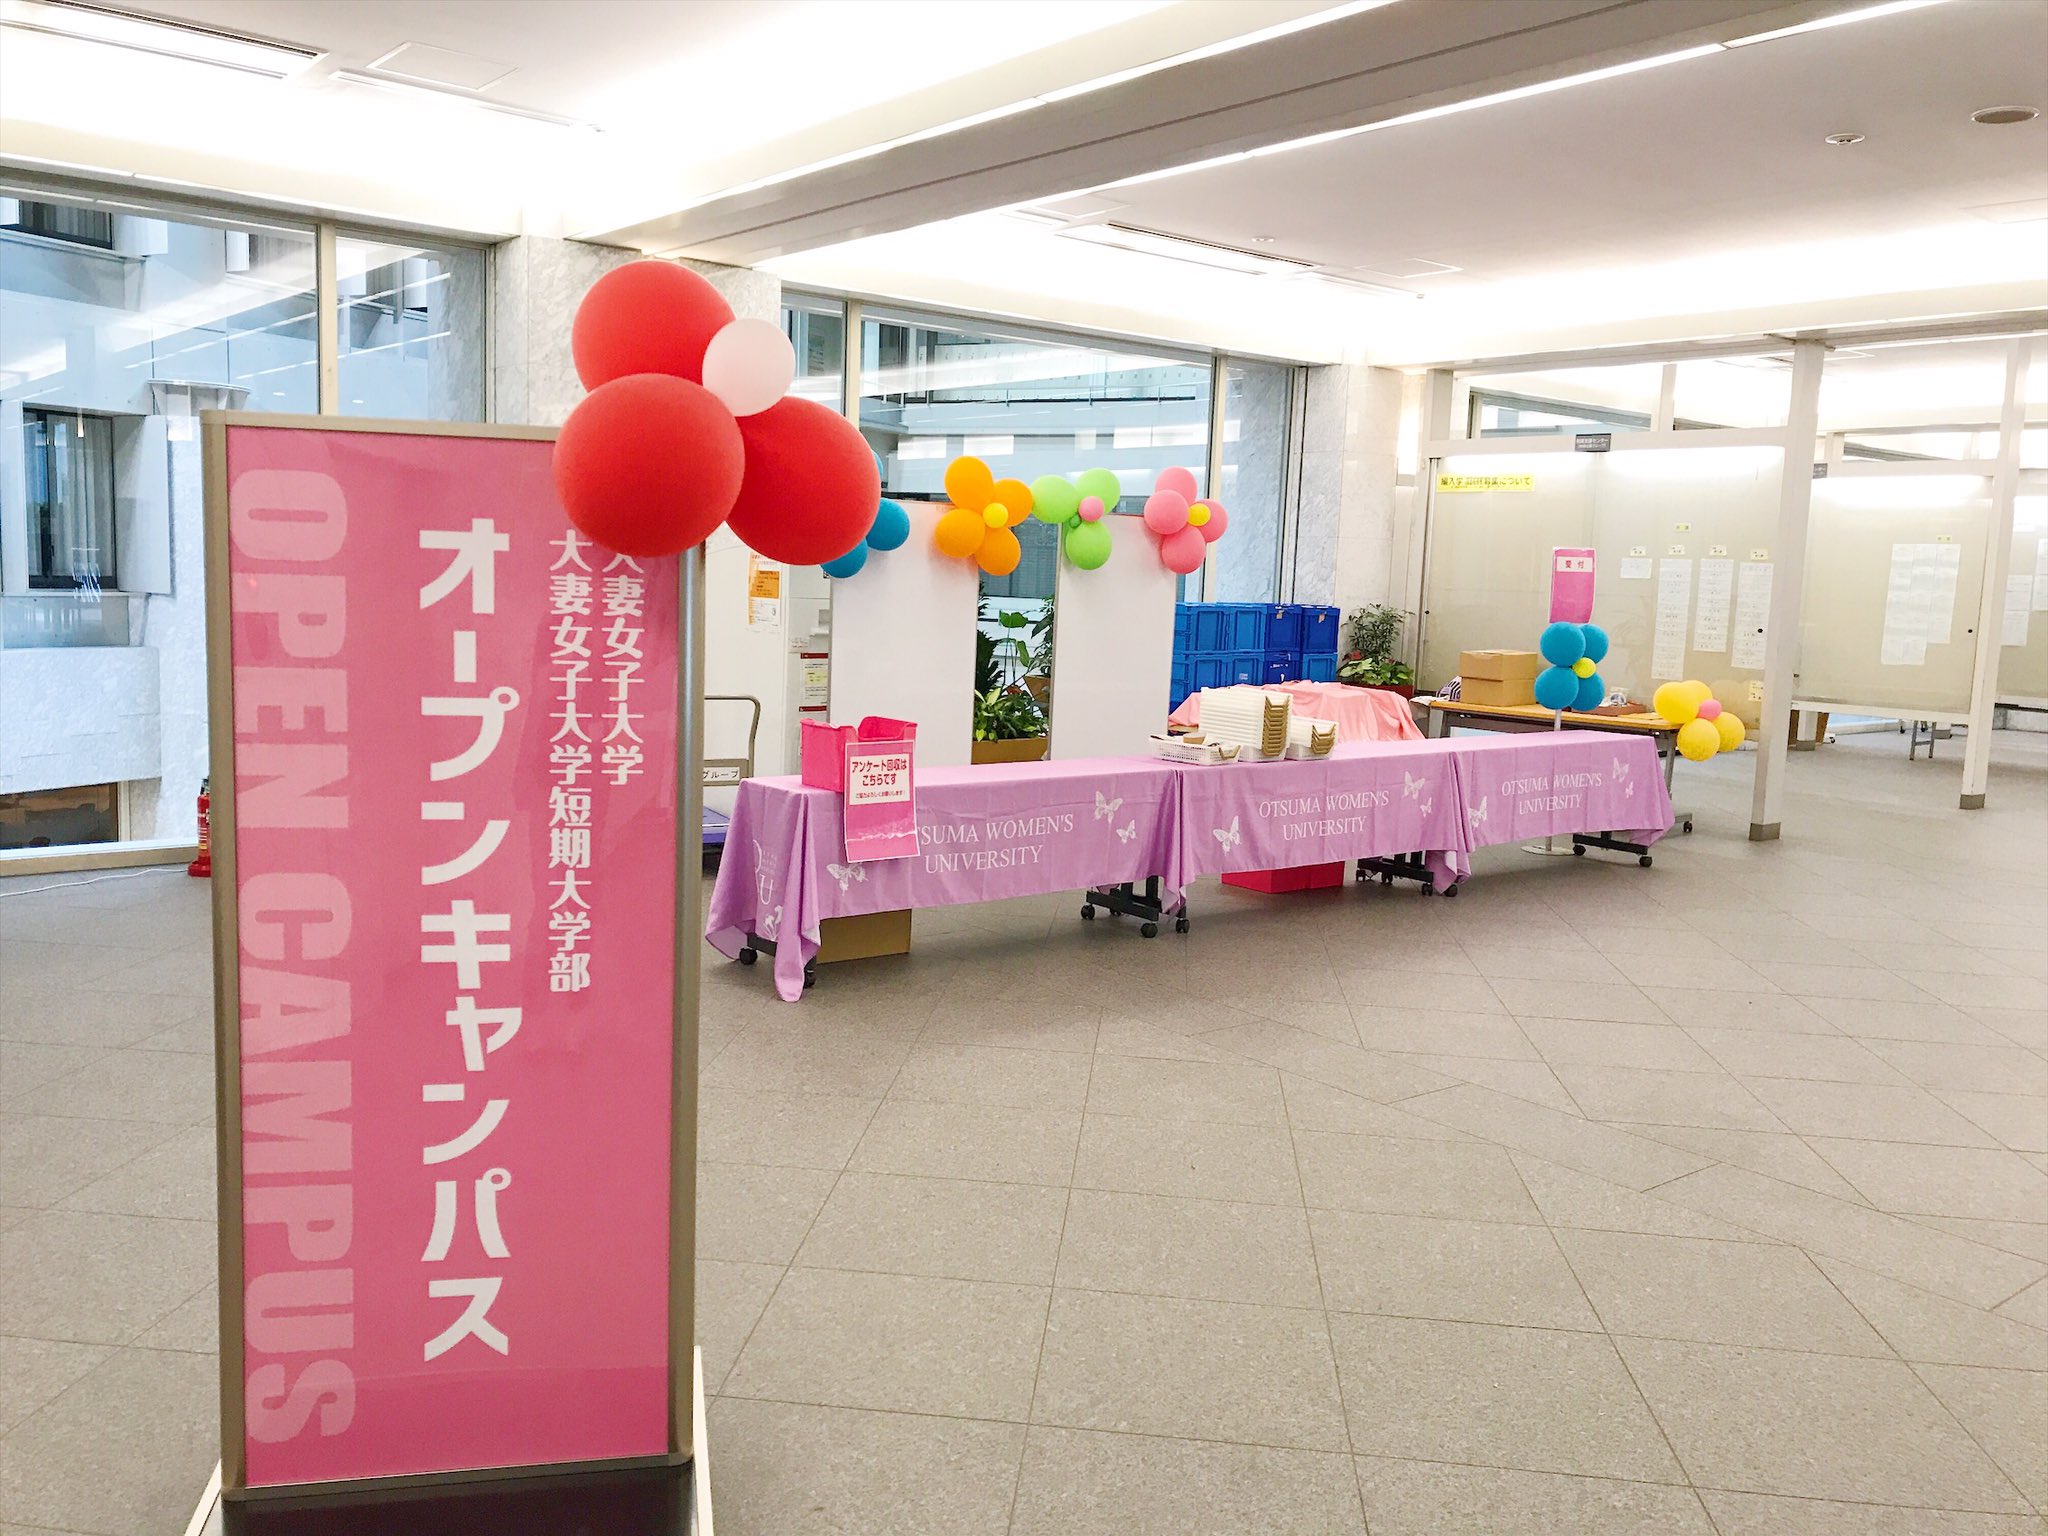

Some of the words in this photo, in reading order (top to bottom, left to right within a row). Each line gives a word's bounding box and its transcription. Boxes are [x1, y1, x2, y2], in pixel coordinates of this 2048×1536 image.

[230, 468, 350, 829] OPEN
[549, 528, 593, 993] 大妻女子大学短期大学部
[852, 758, 907, 773] アンケート回収は
[862, 773, 897, 786] こちらです
[1501, 775, 1549, 797] OTSUMA
[1553, 772, 1602, 790] WOMEN'S
[1259, 797, 1321, 818] OTSUMA
[1326, 790, 1390, 811] WOMEN'S
[1519, 794, 1583, 815] UNIVERSITY
[916, 824, 979, 845] SUMA
[986, 813, 1074, 840] WOMEN'S
[1282, 815, 1367, 841] UNIVERSITY
[924, 844, 1044, 874] UNIVERSITY
[418, 517, 523, 1362] オープンキャンパス
[239, 872, 356, 1444] CAMPUS
